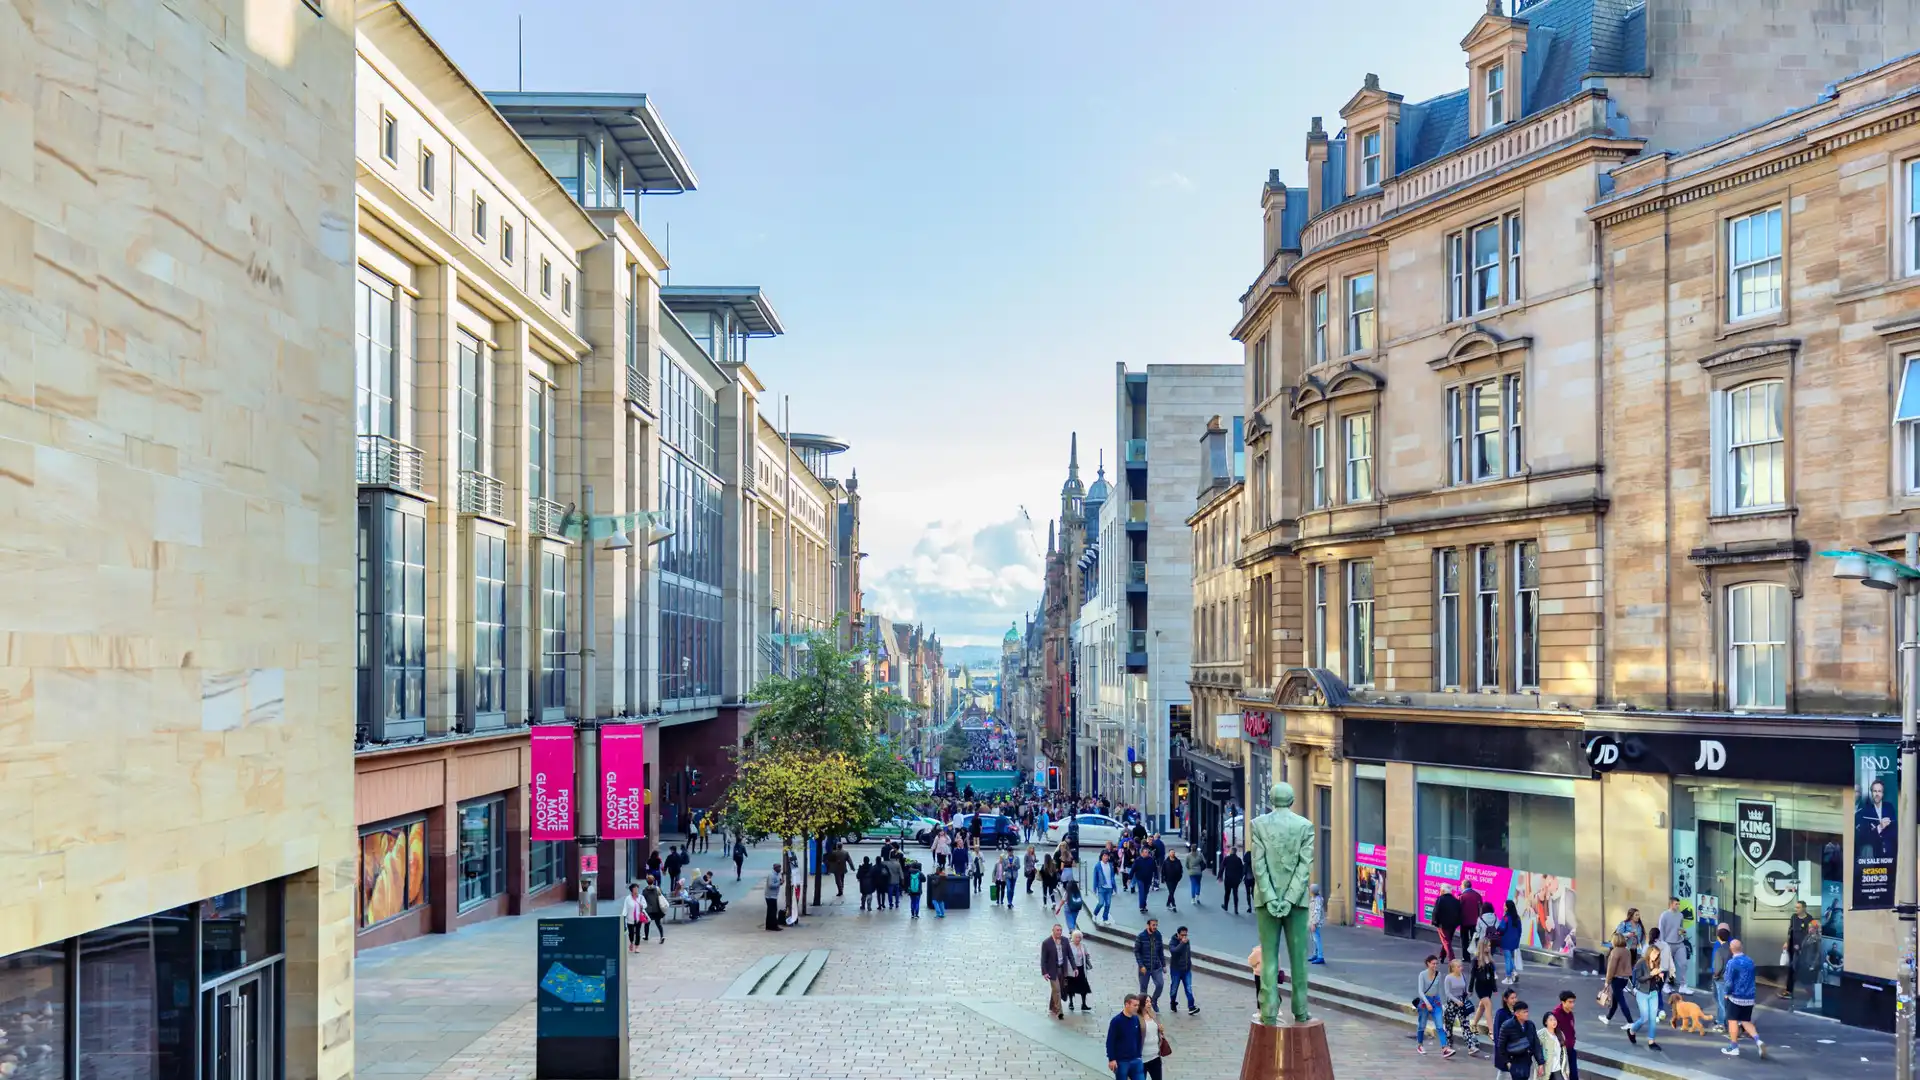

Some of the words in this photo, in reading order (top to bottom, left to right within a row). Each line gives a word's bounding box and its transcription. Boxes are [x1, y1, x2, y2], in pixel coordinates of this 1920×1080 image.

[1594, 744, 1619, 765] JD
[1695, 740, 1726, 771] JD
[1860, 756, 1890, 770] RSNO
[536, 772, 547, 831] GLASGOW
[547, 799, 558, 831] MAKE
[558, 789, 569, 831] PEOPLE
[606, 771, 617, 830] GLASGOW
[617, 798, 628, 830] MAKE
[628, 788, 640, 830] PEOPLE
[1740, 820, 1771, 834] KING
[1430, 861, 1441, 874] TO
[1444, 863, 1458, 876] LET
[1863, 867, 1887, 875] season
